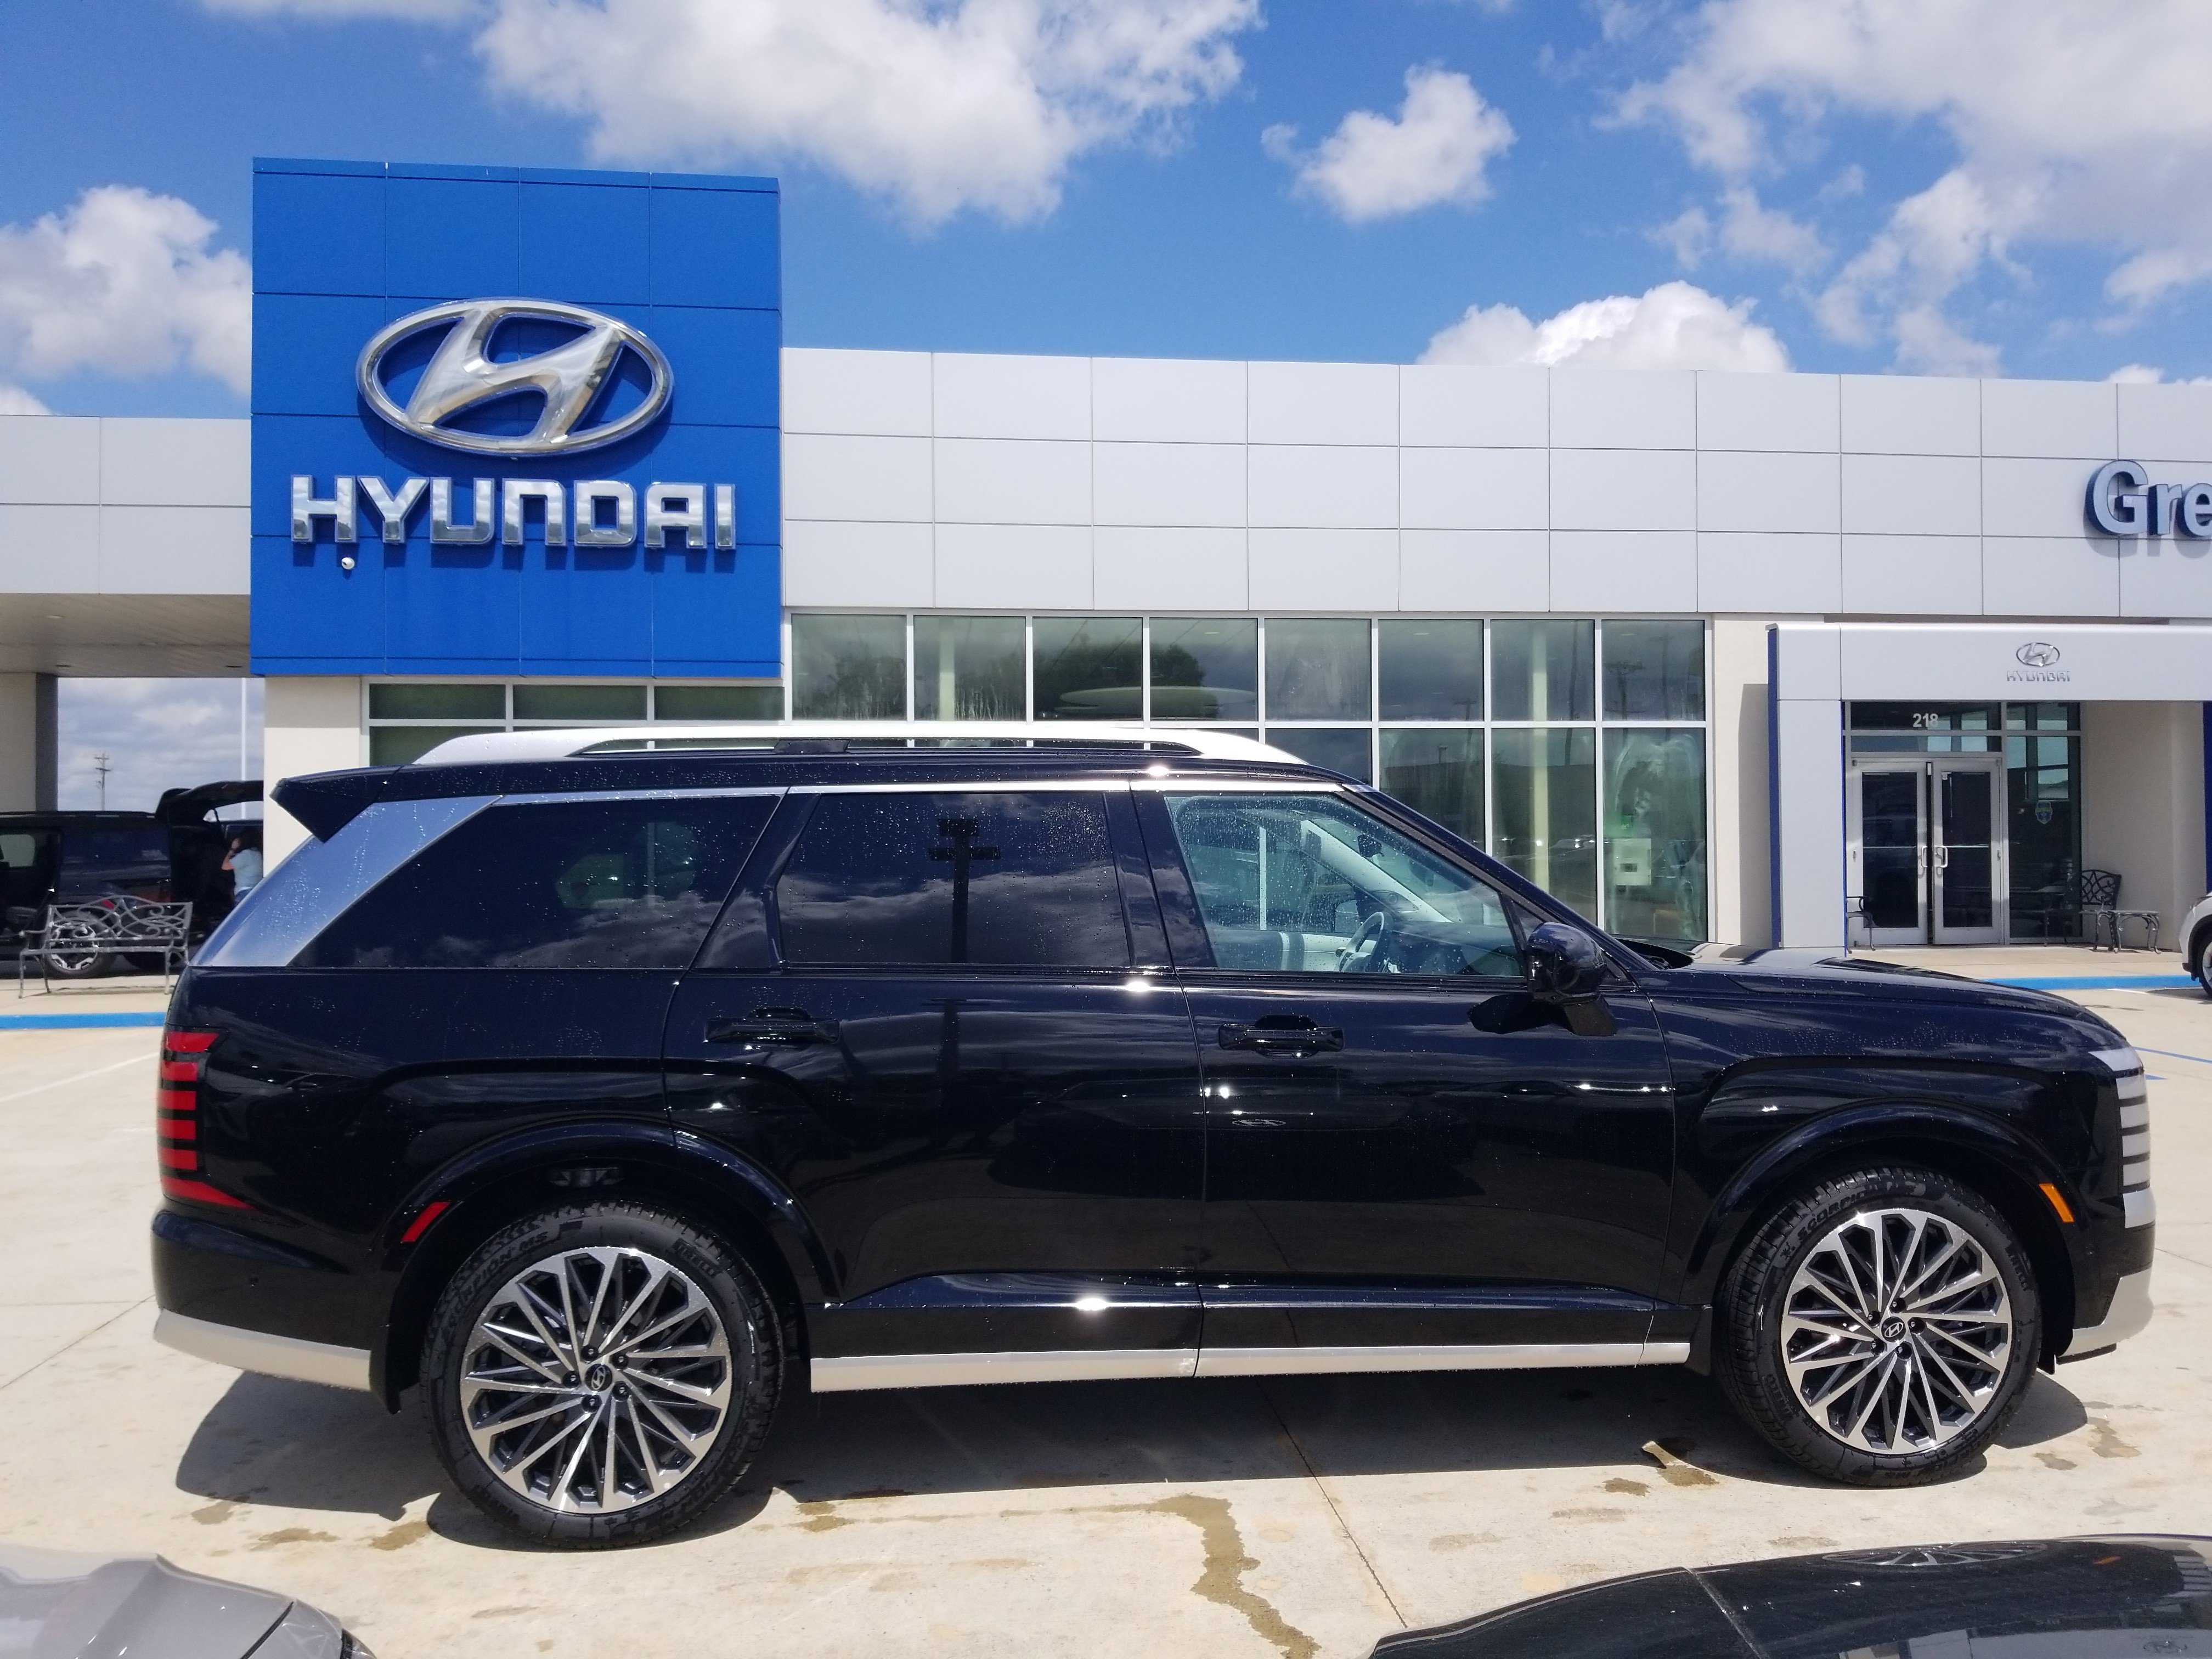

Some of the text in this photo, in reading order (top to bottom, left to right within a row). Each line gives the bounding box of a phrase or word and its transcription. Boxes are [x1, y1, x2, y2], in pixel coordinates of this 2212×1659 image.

[291, 475, 736, 549] HYUNDAI
[2085, 459, 2212, 538] Gre
[2006, 670, 2070, 682] HYUNDAI
[1913, 713, 1938, 727] 218
